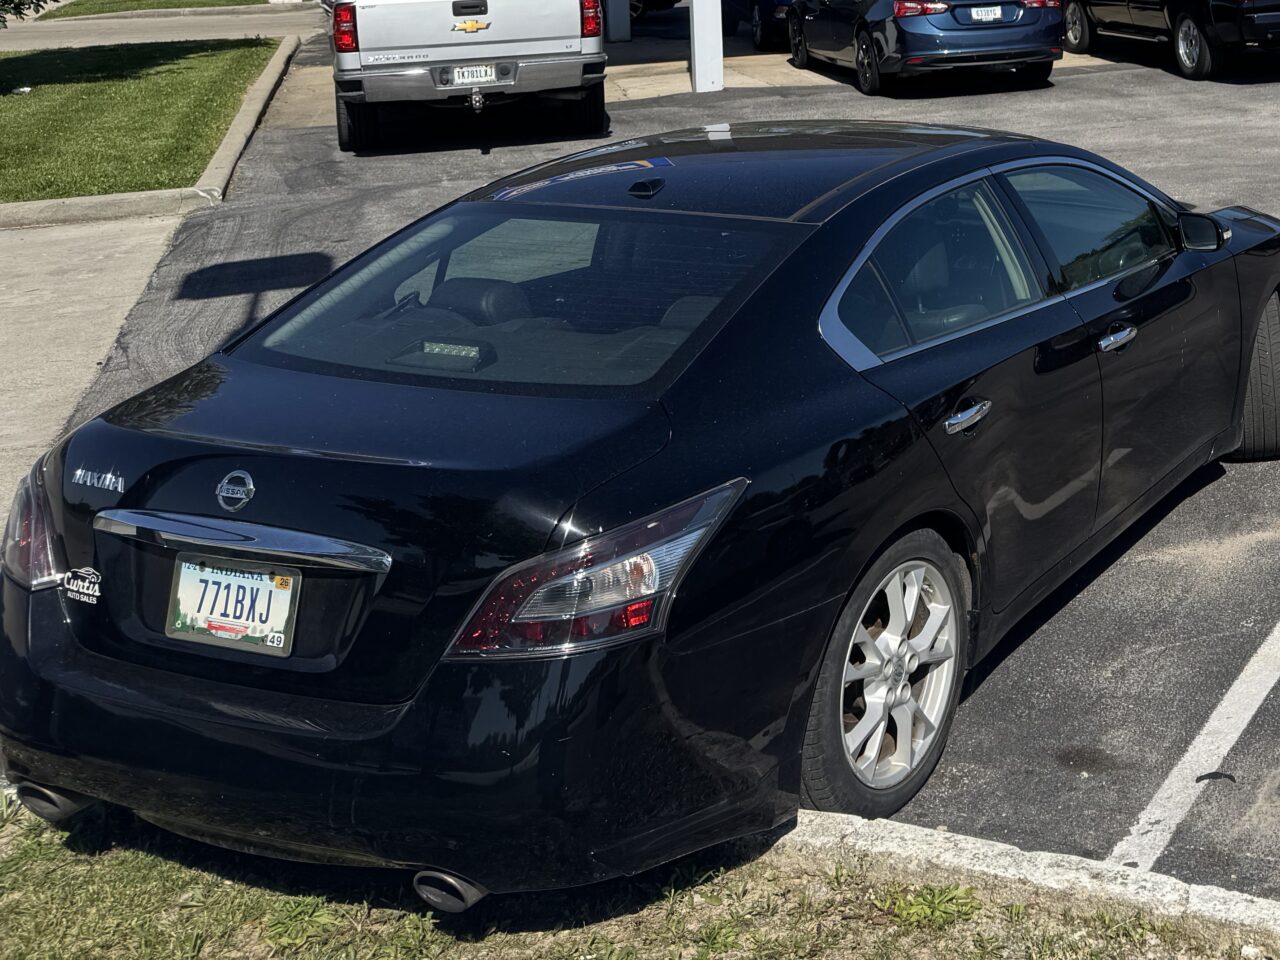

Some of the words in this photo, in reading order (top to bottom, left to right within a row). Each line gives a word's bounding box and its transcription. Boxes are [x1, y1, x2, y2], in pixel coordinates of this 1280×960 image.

[71, 468, 125, 494] MAXIMA
[210, 566, 265, 582] INDIANA
[279, 577, 289, 587] 26
[64, 571, 102, 597] Curtis
[67, 590, 80, 601] AUTO
[80, 593, 98, 604] SALES
[196, 578, 273, 625] 771BXJ
[268, 635, 283, 646] 49
